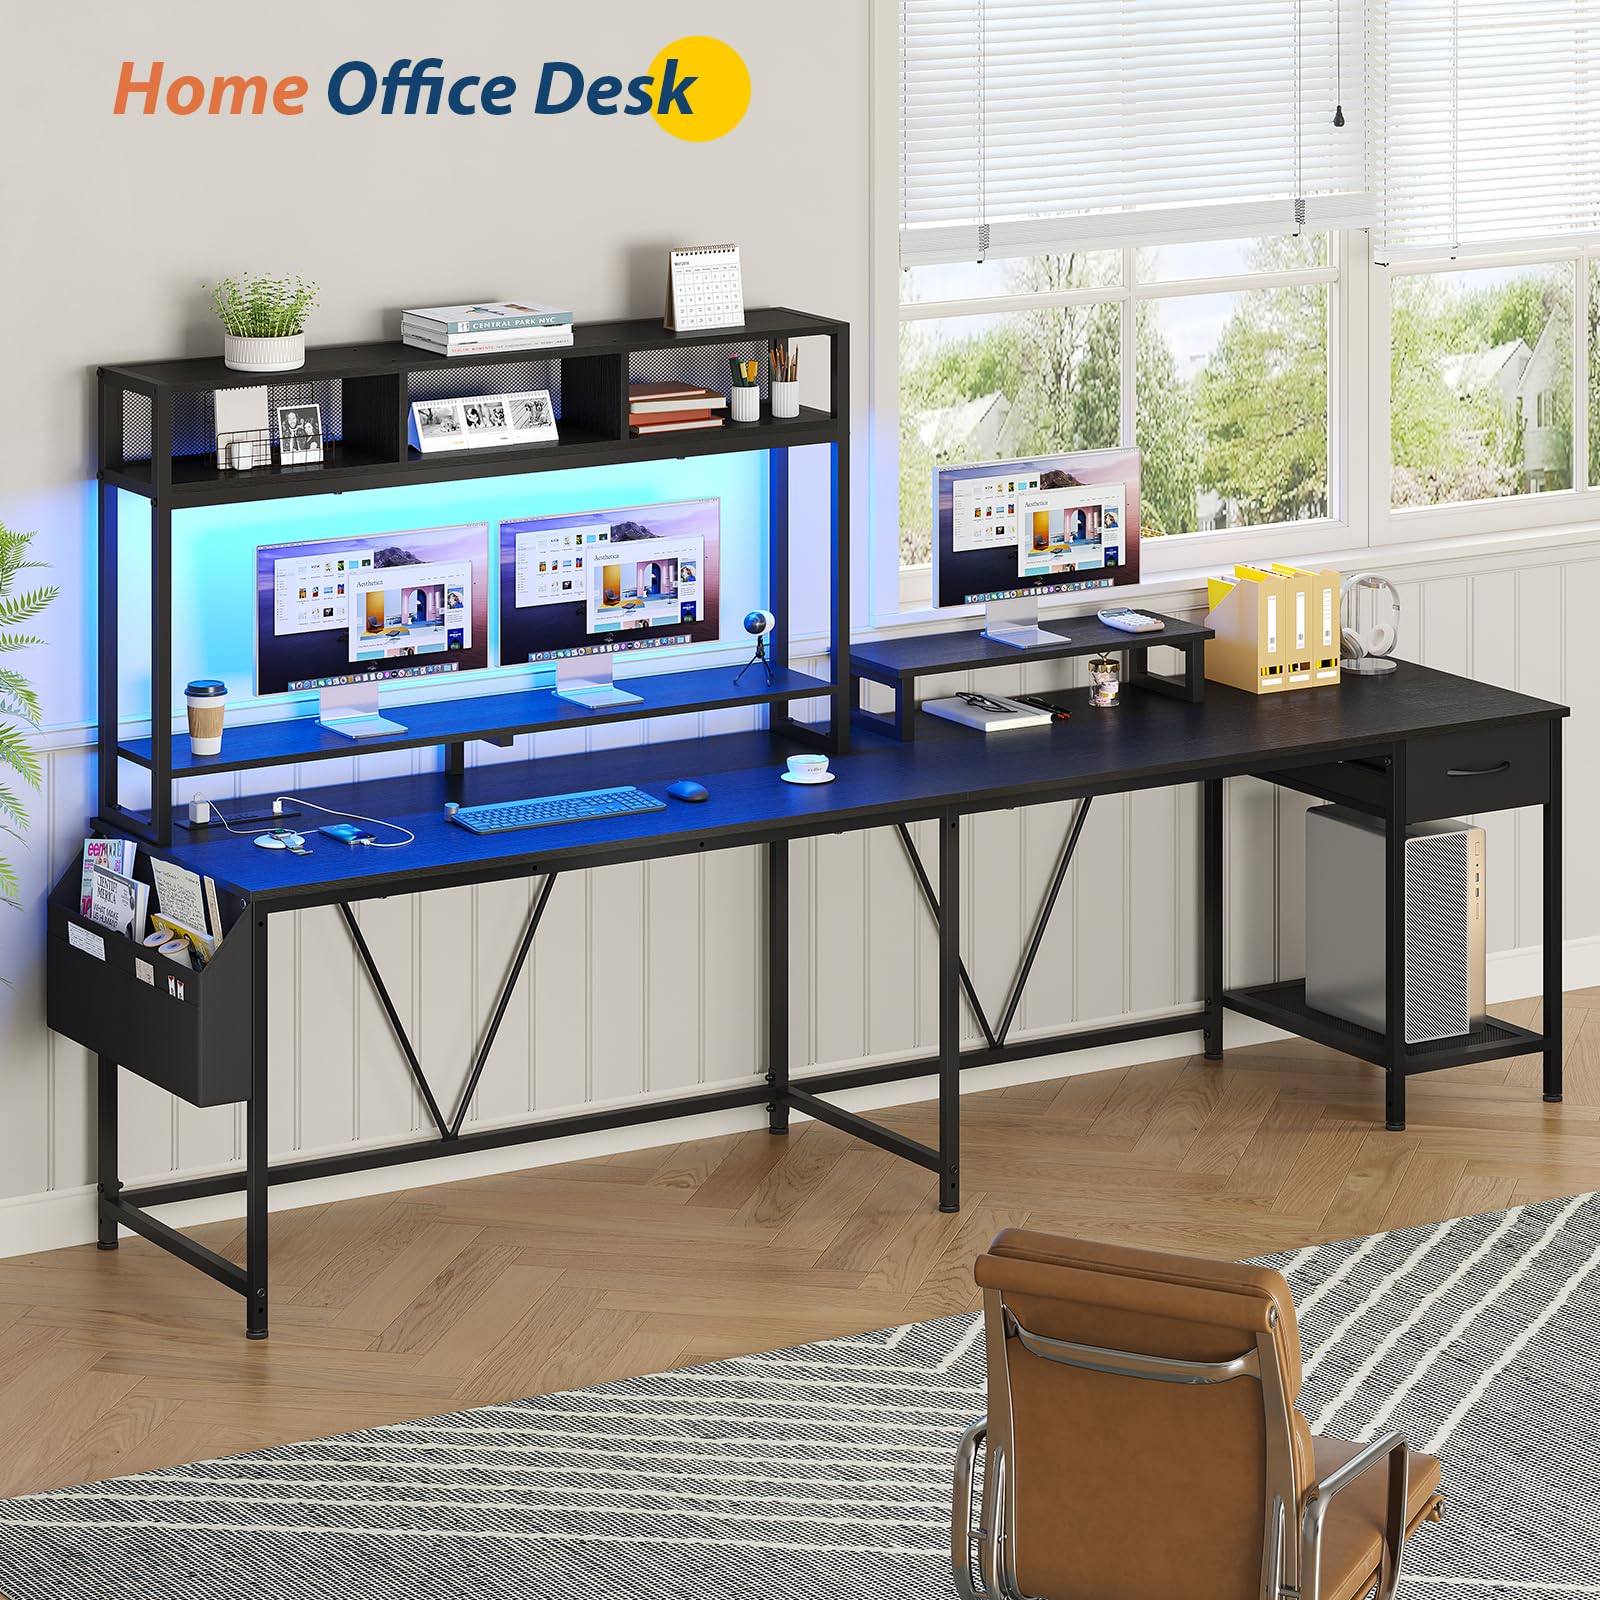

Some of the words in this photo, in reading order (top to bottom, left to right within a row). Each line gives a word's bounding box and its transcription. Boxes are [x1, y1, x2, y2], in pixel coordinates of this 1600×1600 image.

[472, 321, 511, 329] CENTRAL
[515, 318, 536, 326] PARK
[594, 553, 619, 561] Aesthetica
[356, 579, 383, 588] Aesthetica
